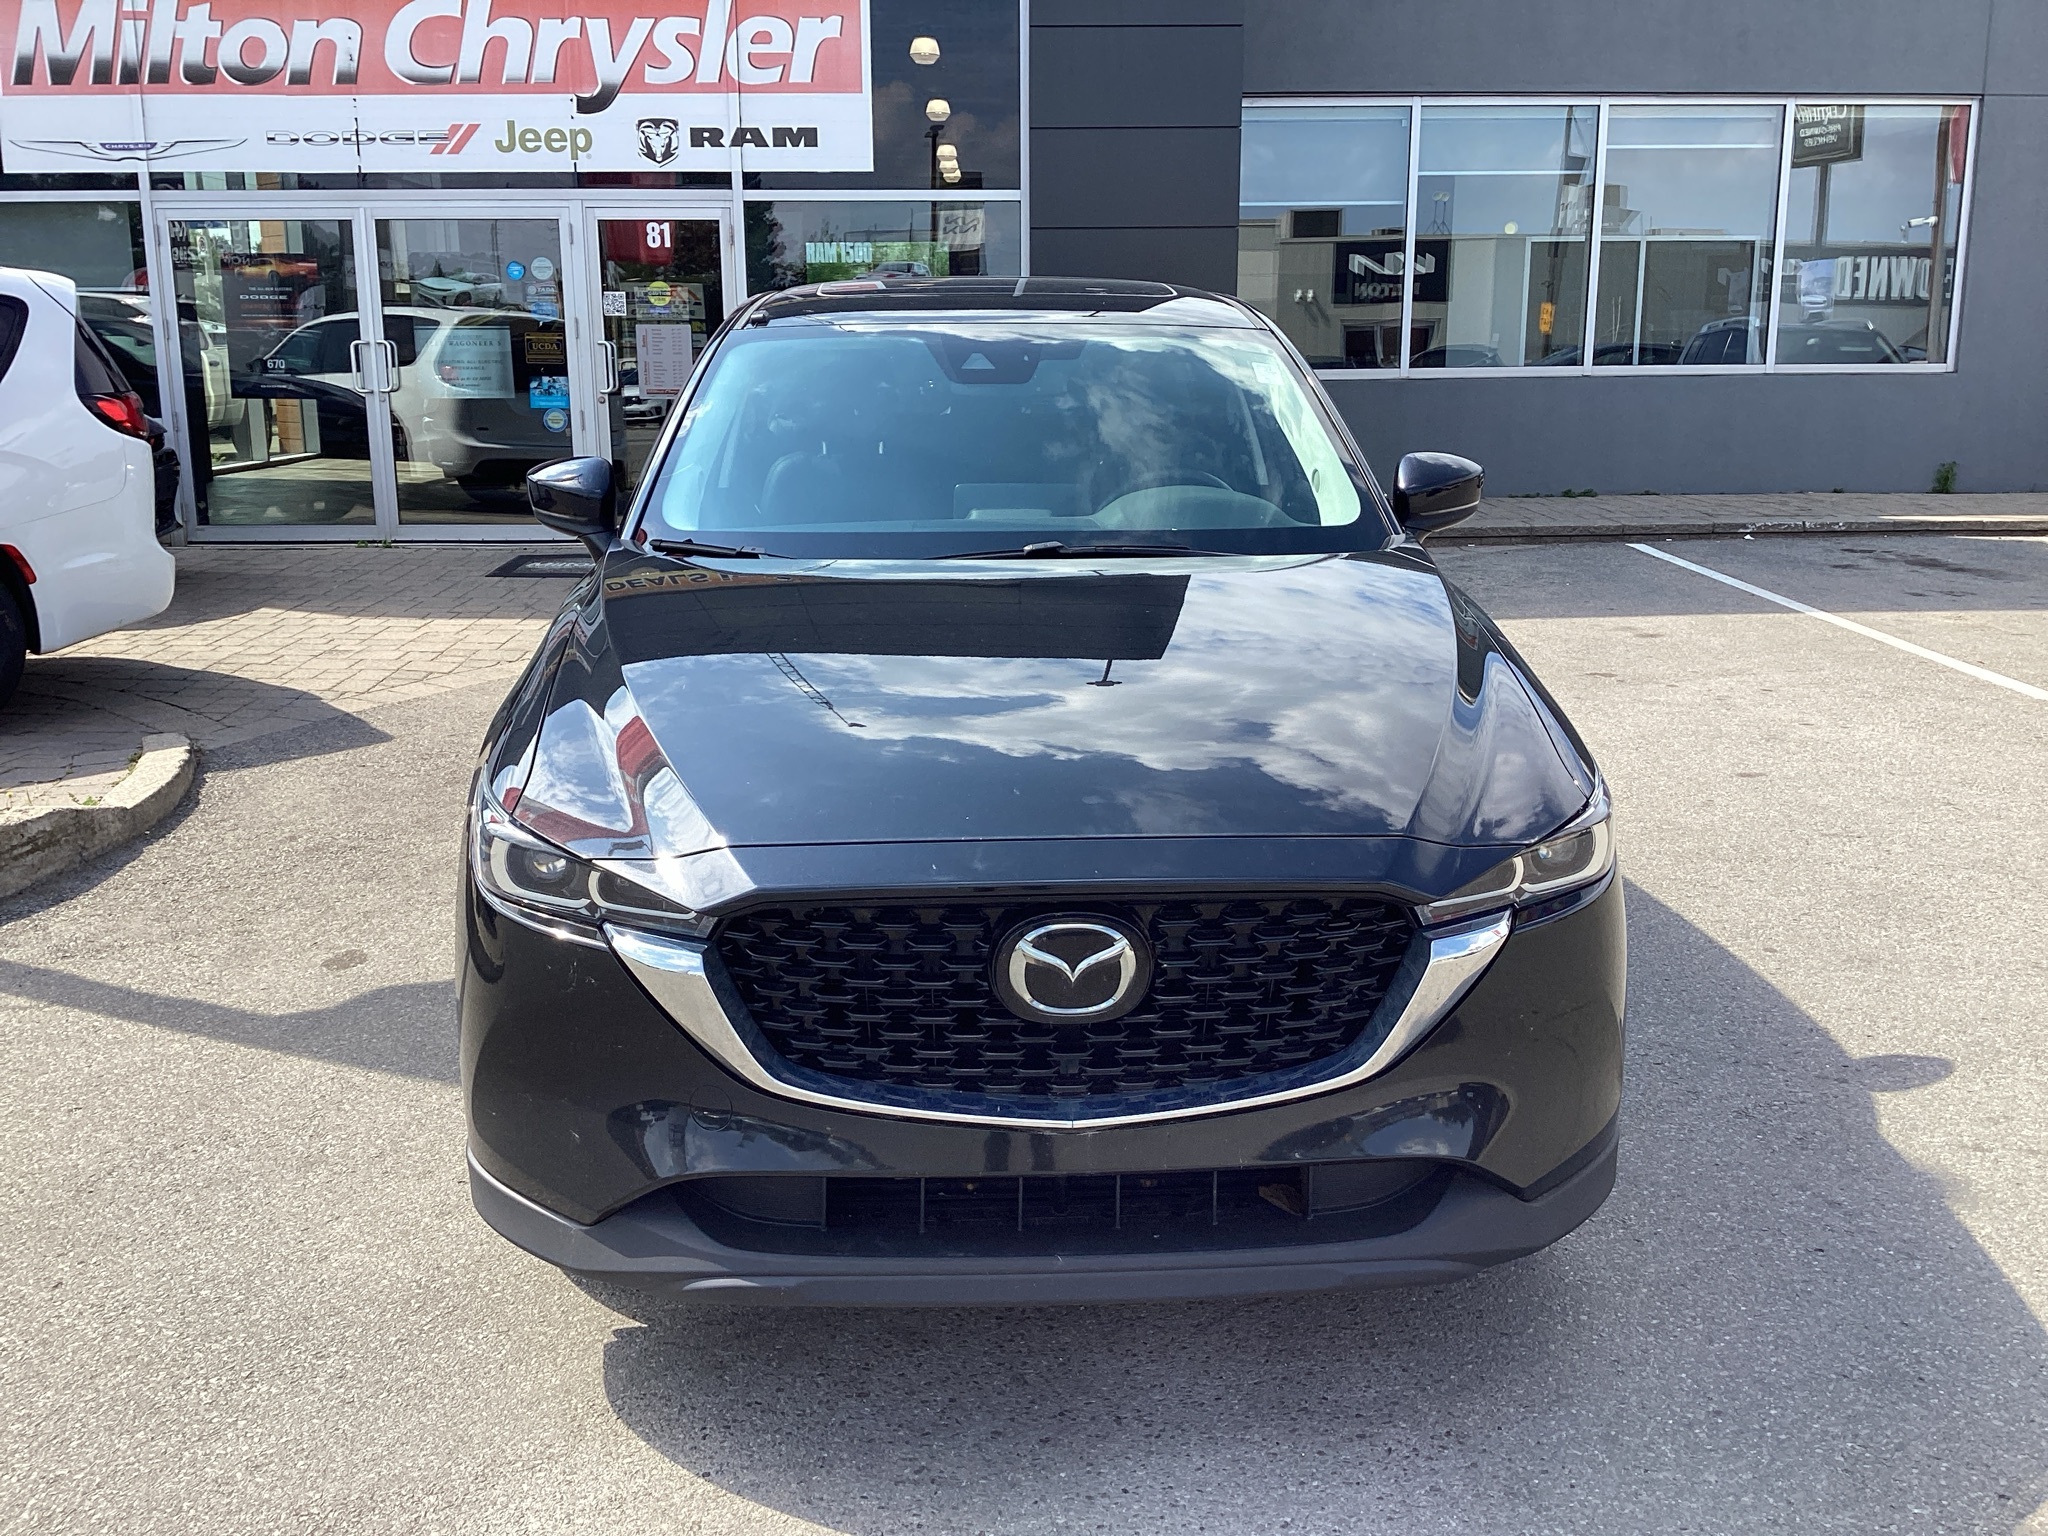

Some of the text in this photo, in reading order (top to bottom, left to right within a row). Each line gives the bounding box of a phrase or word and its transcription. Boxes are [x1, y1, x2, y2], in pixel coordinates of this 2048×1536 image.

[10, 0, 844, 114] Milton Chrysler
[266, 130, 450, 146] DODGE
[495, 120, 593, 160] Jeep
[690, 127, 818, 147] RAM
[646, 221, 671, 248] 81
[806, 242, 873, 264] RAM 1500
[532, 342, 558, 350] UCDA
[267, 359, 286, 369] 670
